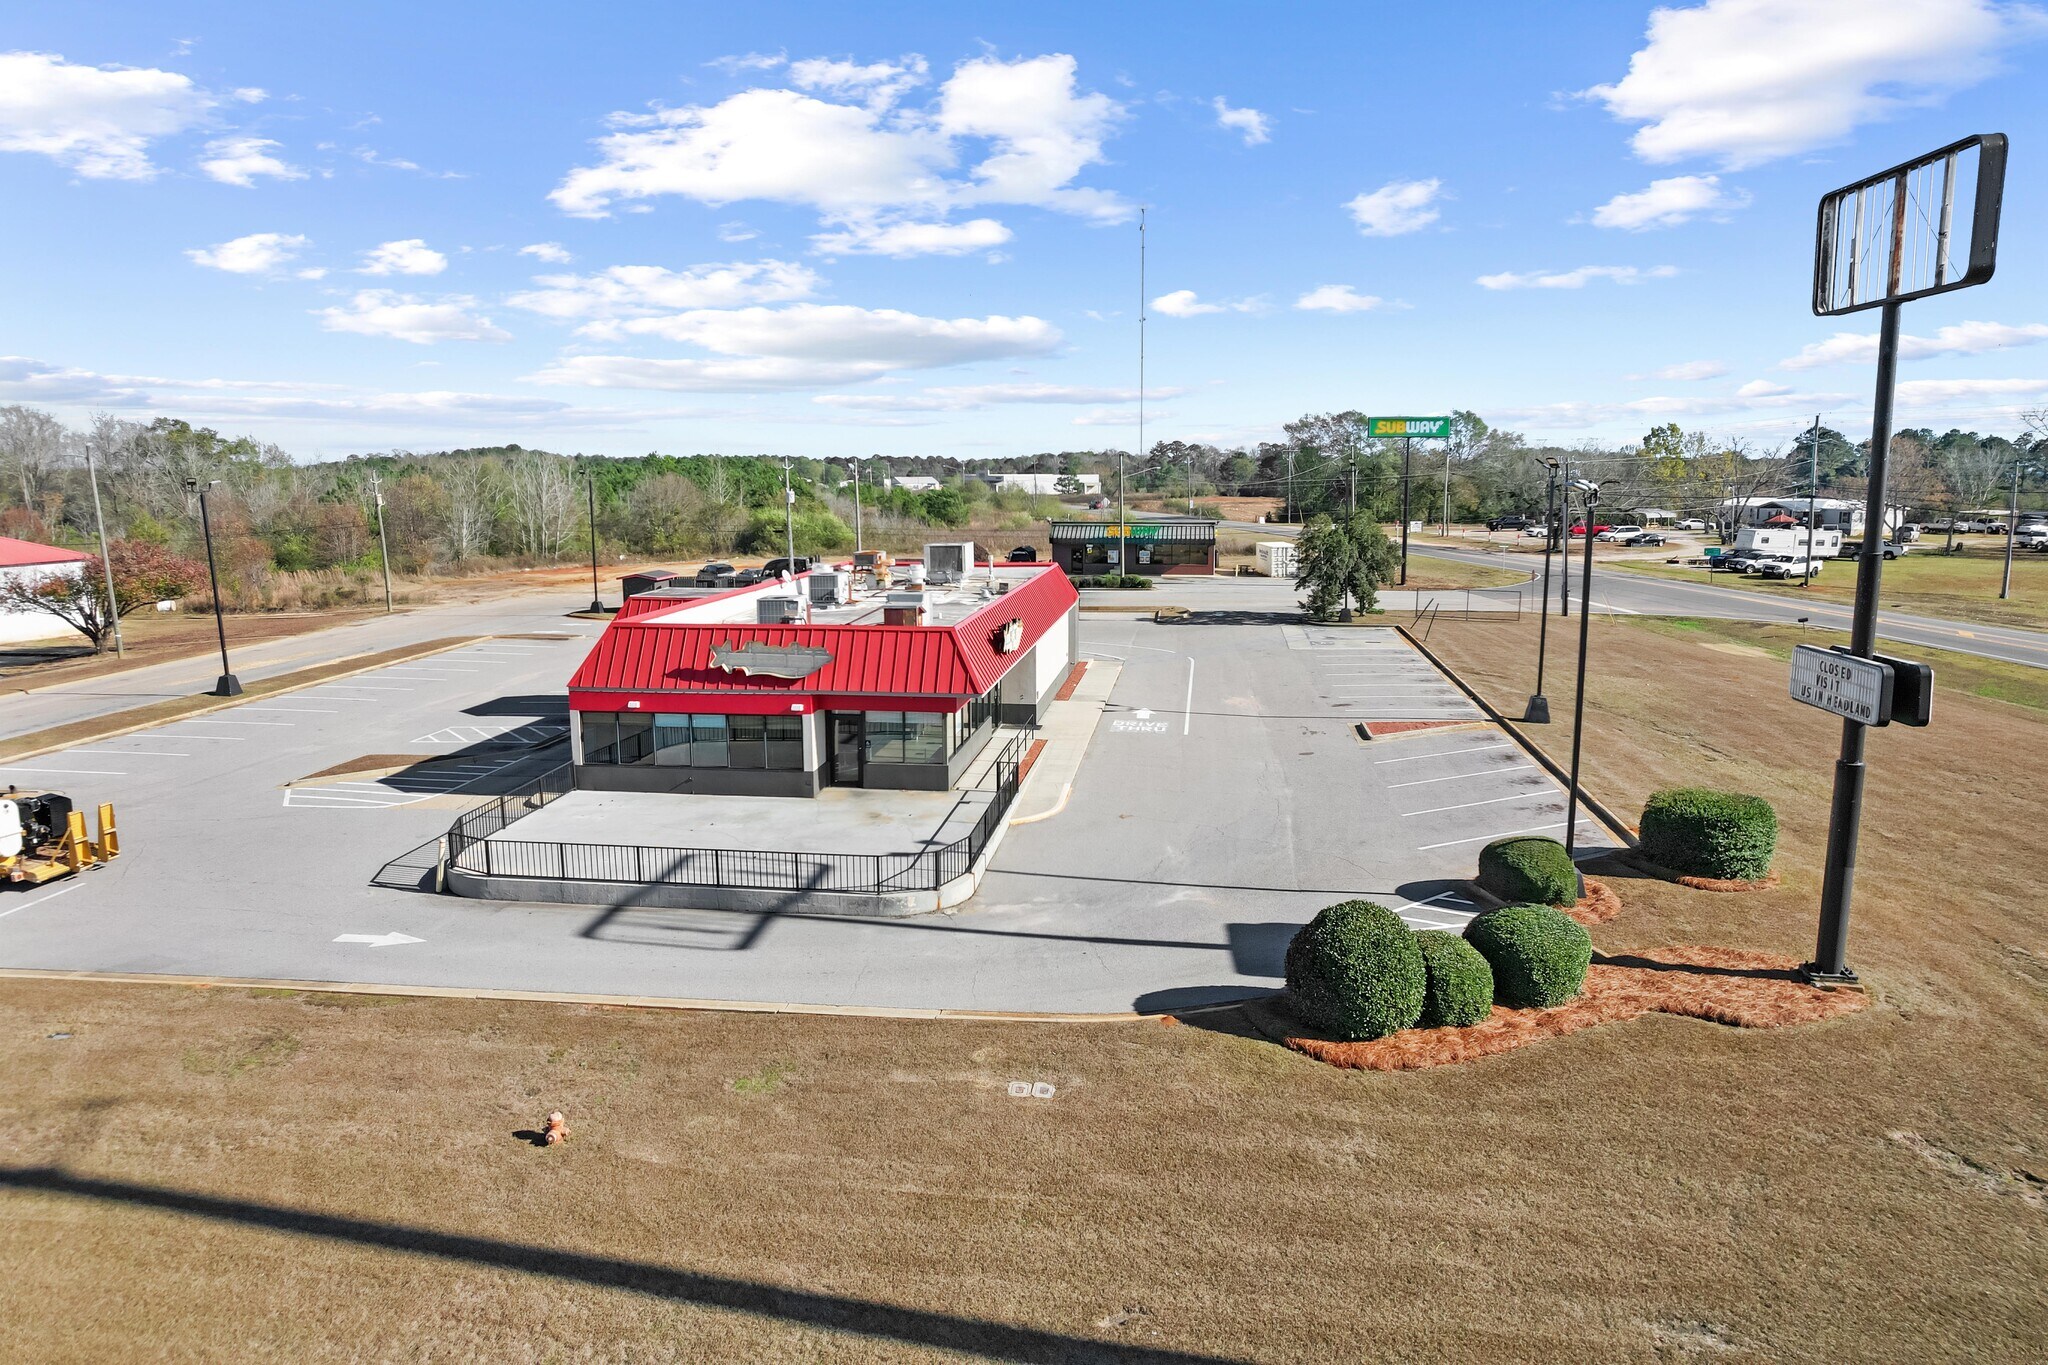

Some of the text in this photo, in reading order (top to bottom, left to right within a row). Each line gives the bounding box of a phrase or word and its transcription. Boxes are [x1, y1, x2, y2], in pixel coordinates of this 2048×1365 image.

[1374, 420, 1444, 434] SUBWAY
[1820, 660, 1852, 680] CLOSED
[1816, 674, 1840, 692] VISIT
[1801, 685, 1871, 719] US IN HEADLAND
